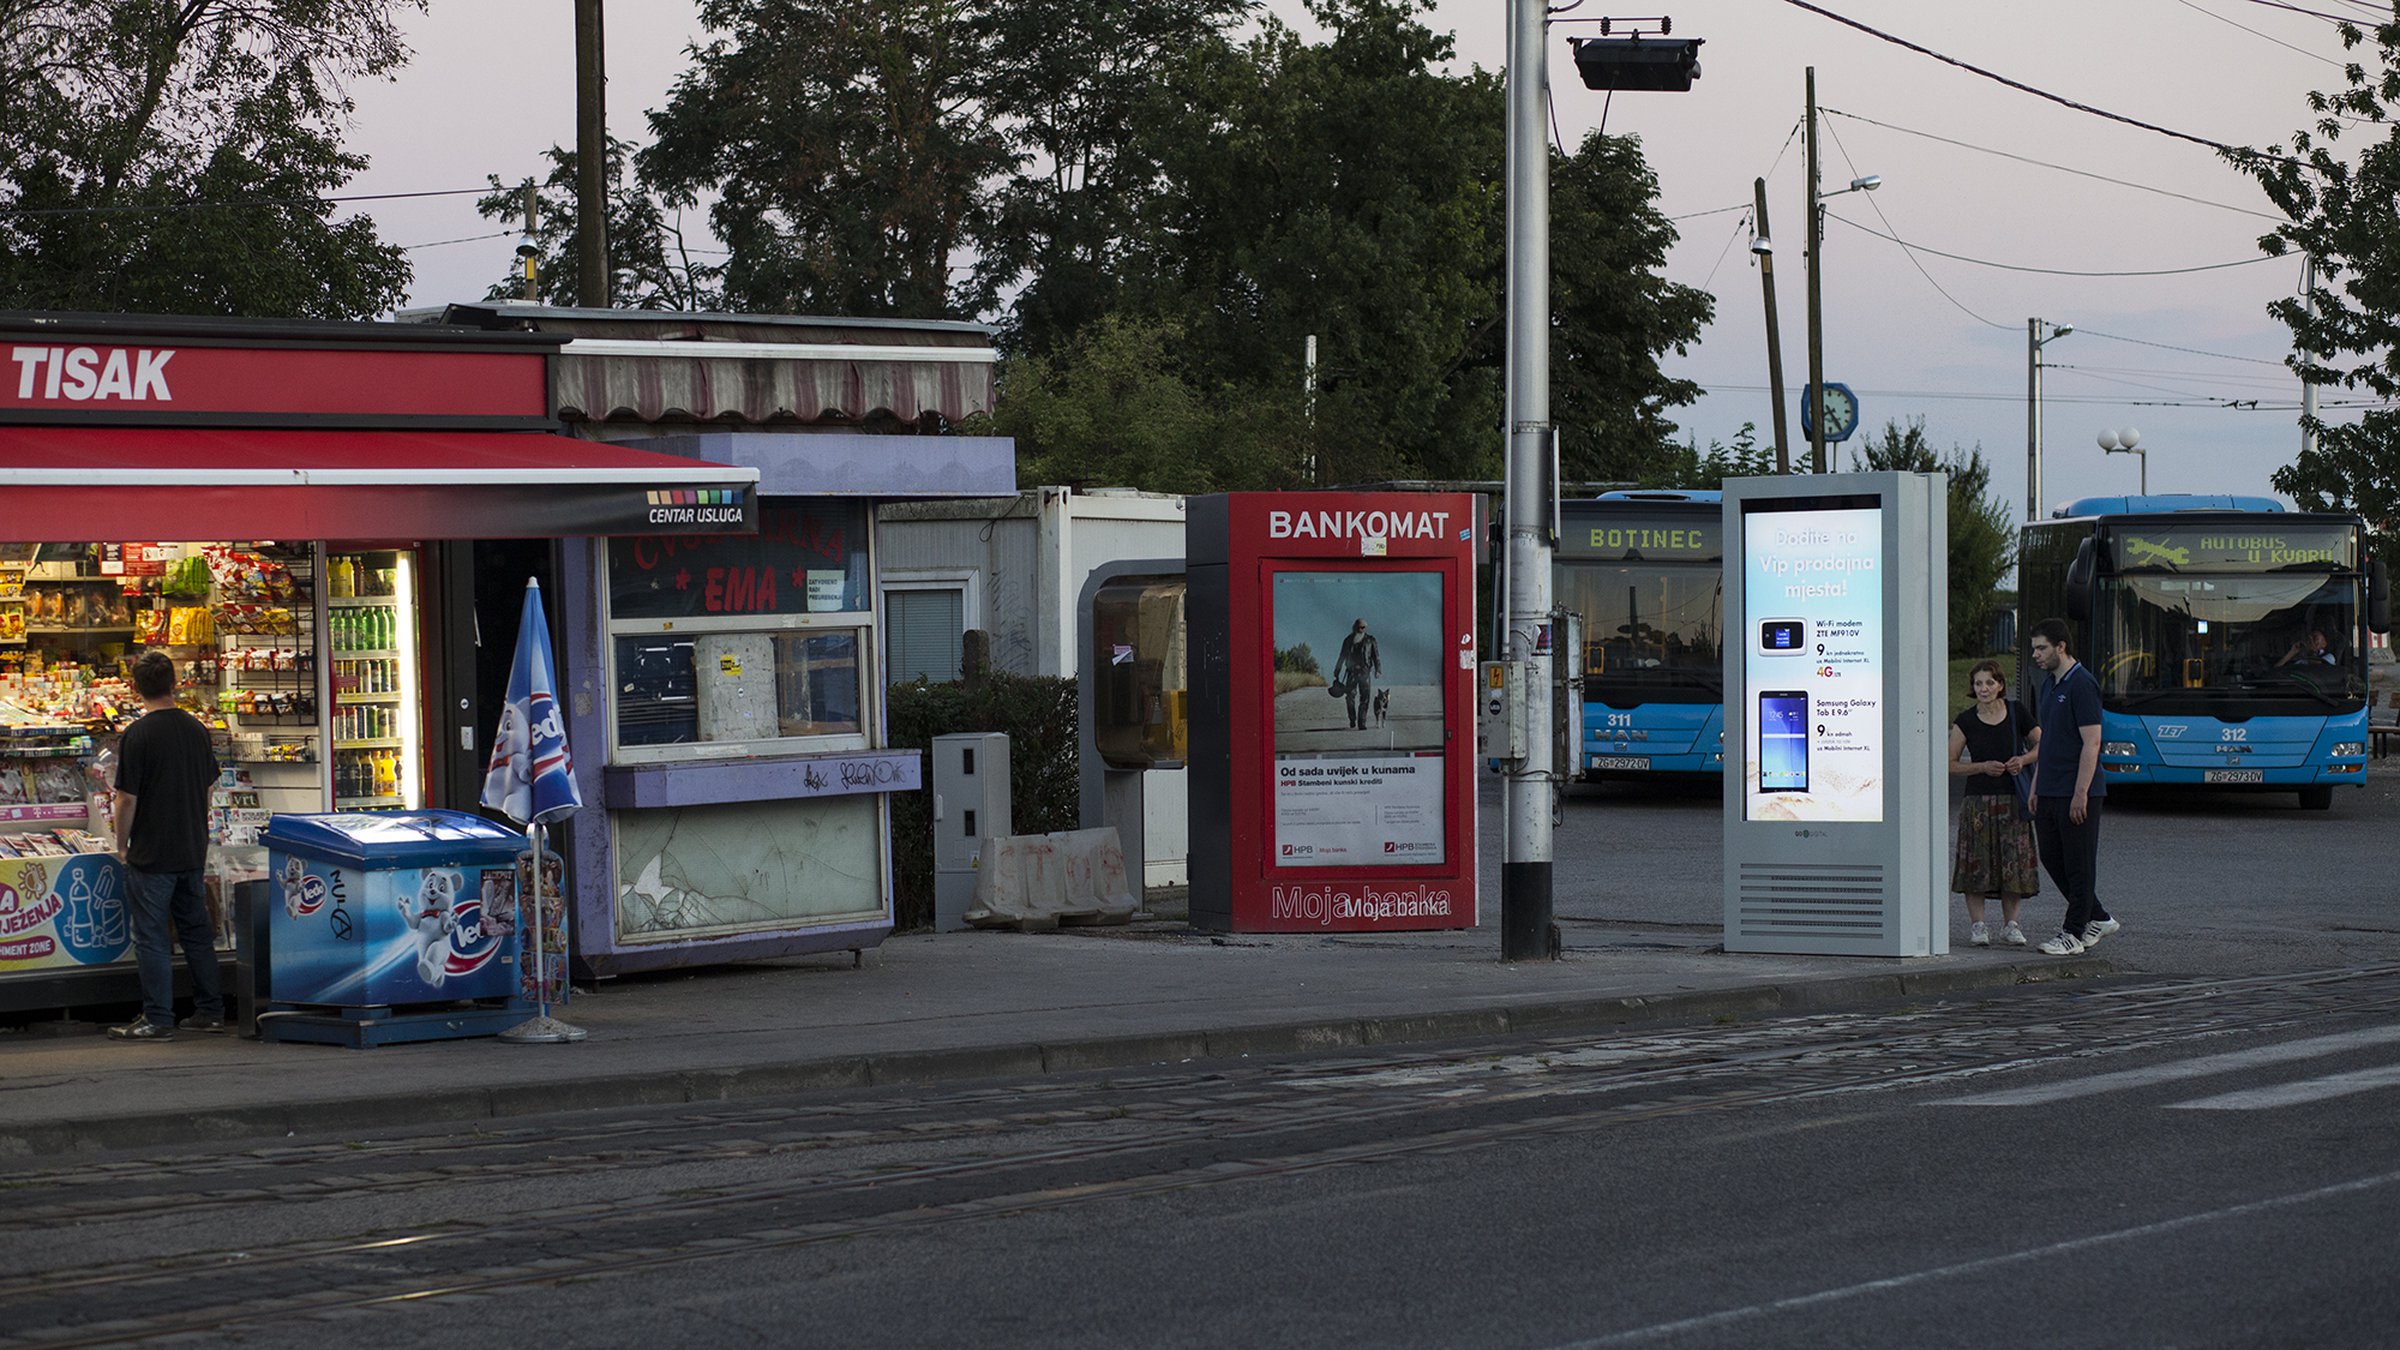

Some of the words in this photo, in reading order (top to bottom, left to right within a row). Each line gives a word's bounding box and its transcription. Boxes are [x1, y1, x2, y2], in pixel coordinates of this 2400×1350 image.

[12, 347, 176, 401] TISAK
[649, 508, 694, 523] CENTAR
[697, 508, 743, 523] USLUGA
[1270, 511, 1449, 539] BANKOMAT
[1590, 529, 1703, 549] BOTINEC
[2201, 537, 2287, 549] AUTOBUS
[2248, 550, 2260, 563] U
[2271, 549, 2332, 563] KVARU
[1760, 555, 1788, 577] Vip
[1794, 553, 1874, 576] prodajna
[705, 565, 776, 612] EMA
[1784, 579, 1847, 602] mjesta!
[1816, 643, 1825, 656] 9
[1816, 666, 1833, 678] 4G
[1816, 699, 1848, 708] Samsung
[1850, 699, 1876, 708] Galaxy
[1607, 713, 1631, 727] 311
[1595, 729, 1648, 740] MAN
[1816, 724, 1826, 737] 9
[2158, 725, 2188, 738] ZET
[2222, 728, 2247, 741] 312
[2215, 745, 2252, 753] MAN
[1598, 757, 1610, 768] ZG
[1280, 767, 1296, 777] Od
[1299, 766, 1324, 776] sada
[1327, 766, 1359, 777] uvijek
[1362, 767, 1369, 775] u
[1371, 765, 1416, 775] kunama
[2210, 771, 2223, 781] ZG
[1298, 779, 1332, 787] Stambeni
[1294, 845, 1313, 854] HPB
[1396, 842, 1415, 851] HPB
[303, 883, 325, 901] ledo
[1272, 886, 1351, 925] Moja
[1364, 884, 1451, 918] banka
[1345, 897, 1390, 921] Moja
[1397, 897, 1449, 917] banka
[0, 893, 62, 935] JEŽENJA
[28, 939, 52, 954] ZONE
